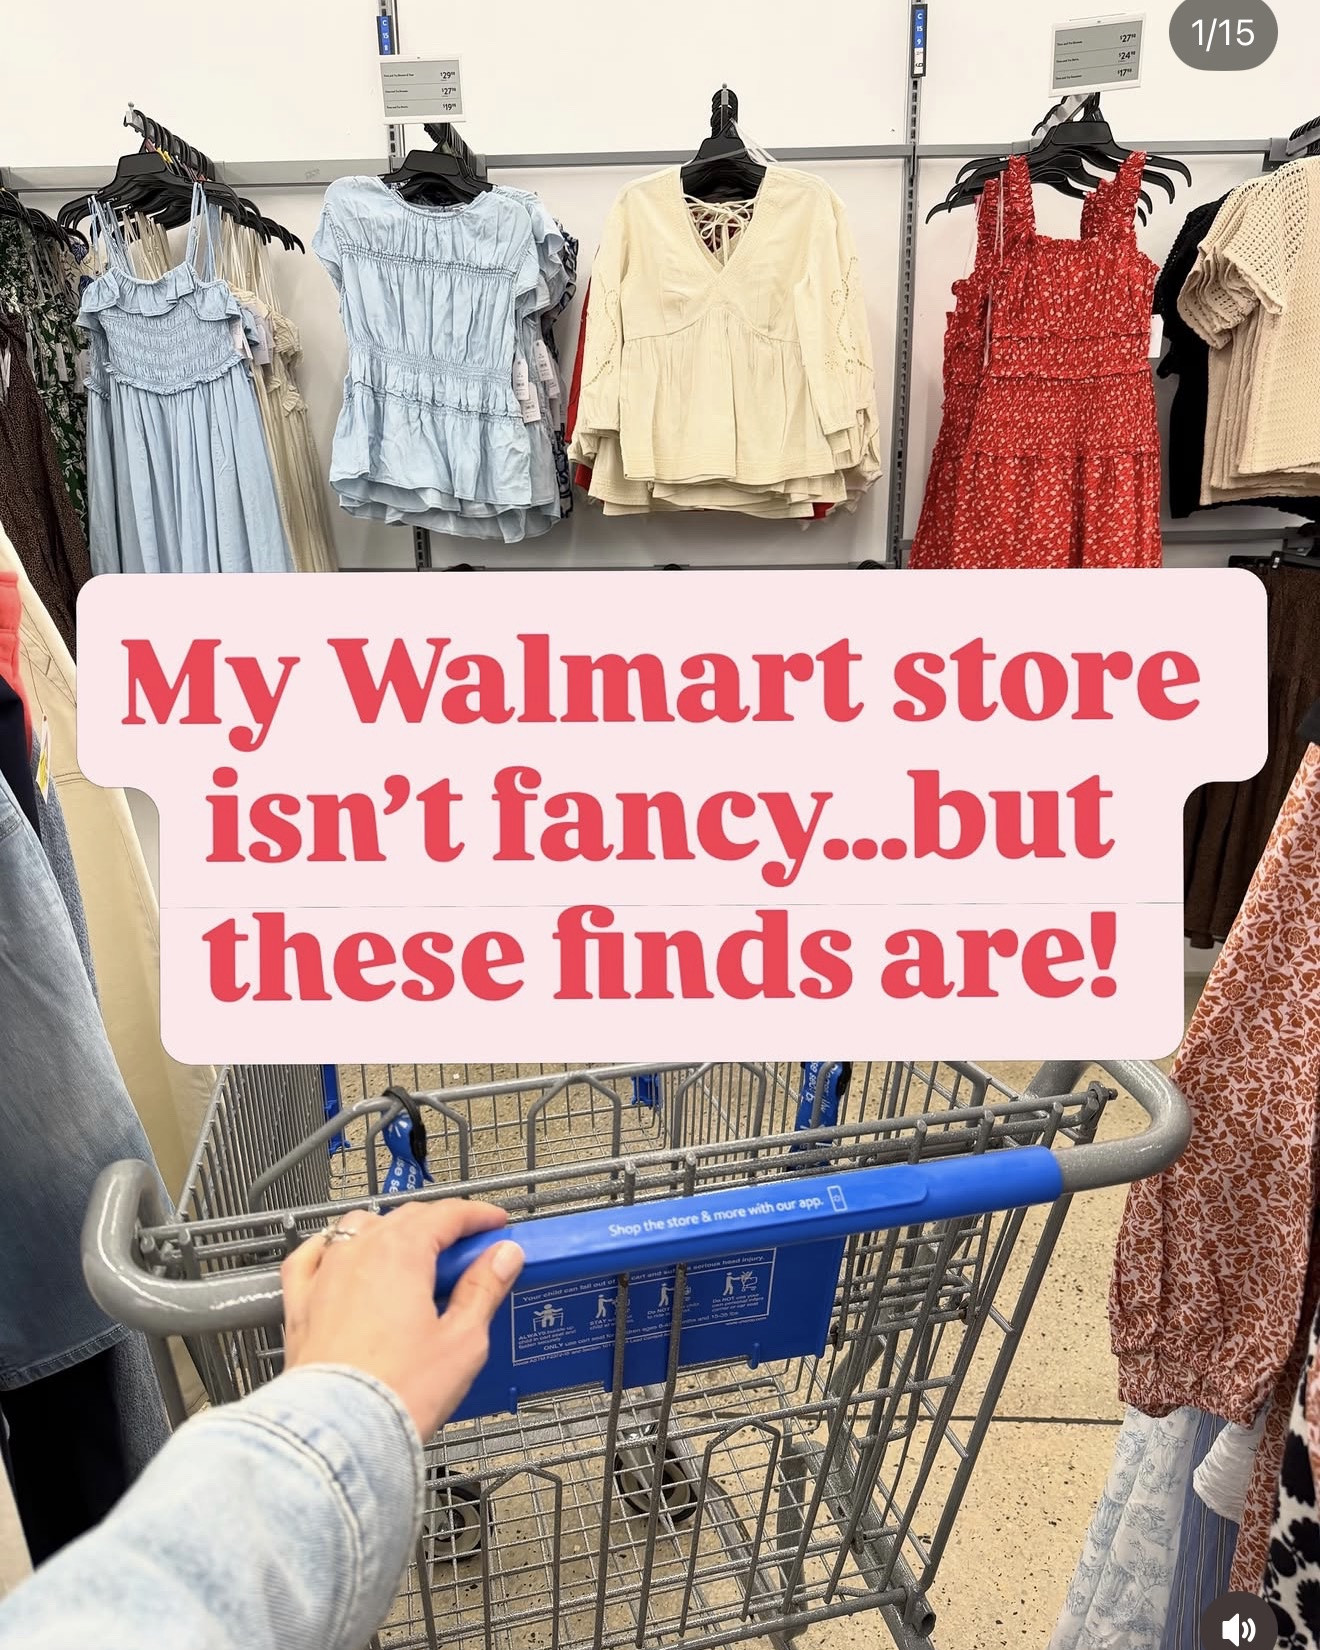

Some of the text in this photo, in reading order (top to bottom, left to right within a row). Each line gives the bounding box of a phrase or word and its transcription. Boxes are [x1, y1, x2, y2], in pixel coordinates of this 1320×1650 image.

[608, 1196, 824, 1237] Shop the store & more with our app.
[543, 1289, 562, 1298] child
[693, 1262, 721, 1270] serious
[722, 1257, 740, 1265] head
[544, 1342, 563, 1350] ONLY
